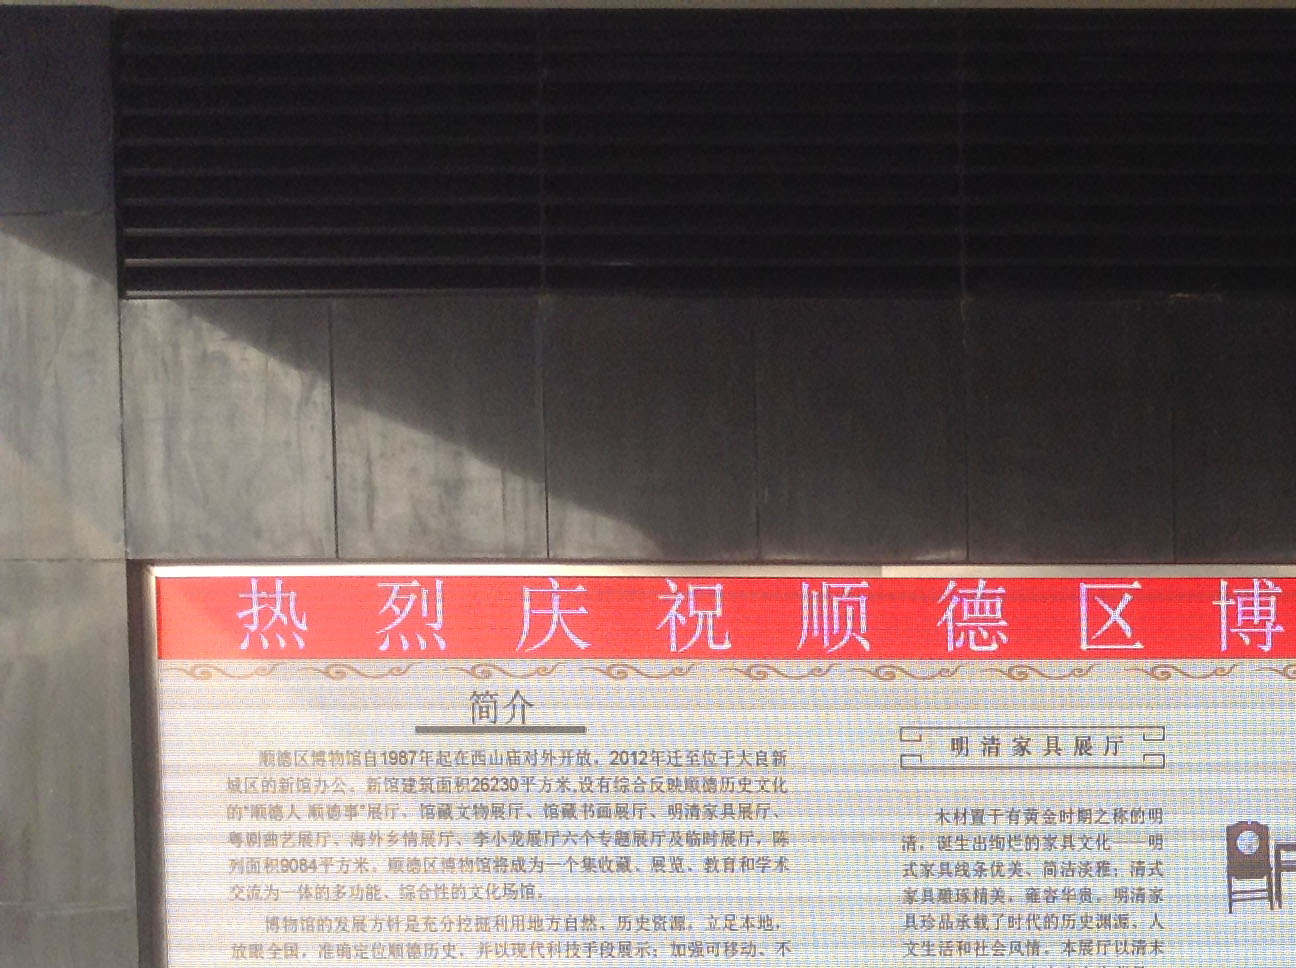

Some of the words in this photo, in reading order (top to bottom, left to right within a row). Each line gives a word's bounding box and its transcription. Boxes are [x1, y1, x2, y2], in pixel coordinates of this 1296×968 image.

[470, 690, 535, 725] 简介
[949, 735, 1126, 757] 明清家具展厅
